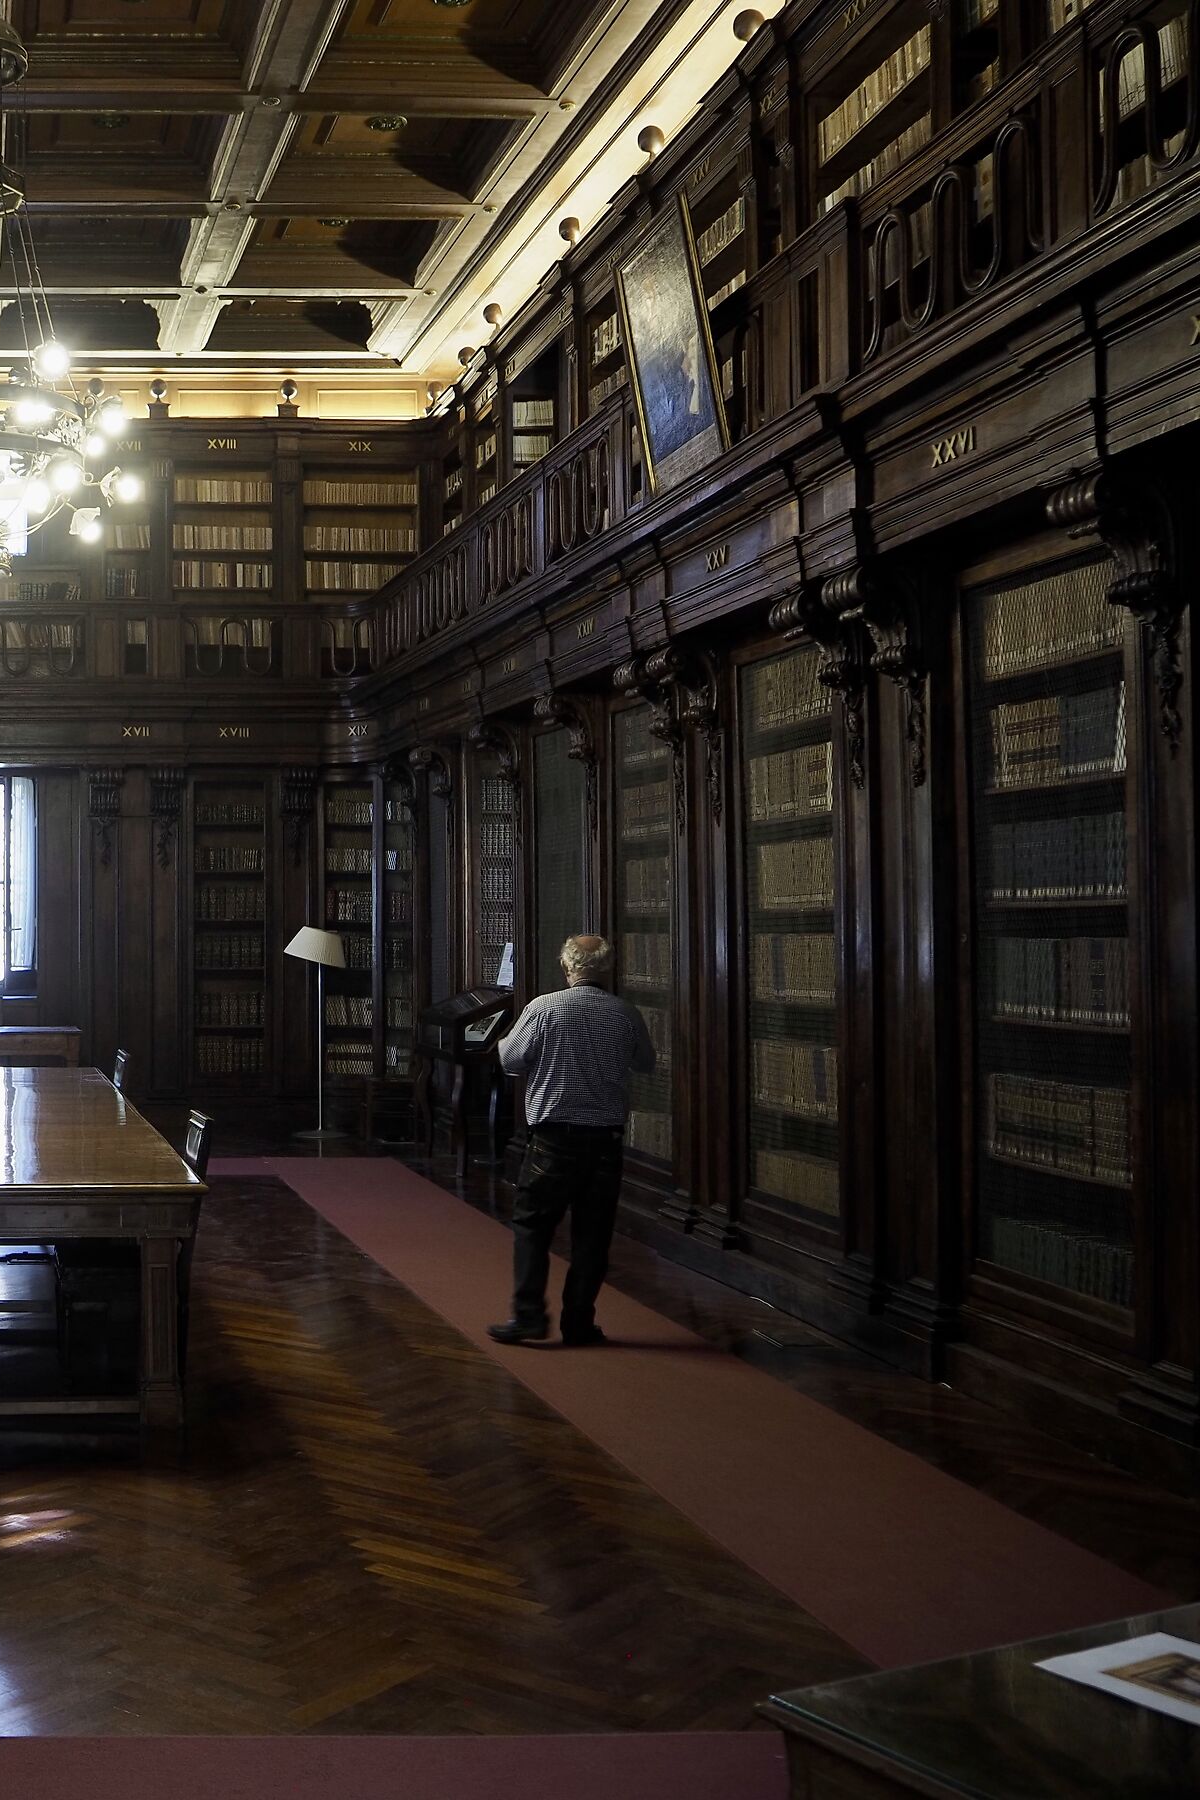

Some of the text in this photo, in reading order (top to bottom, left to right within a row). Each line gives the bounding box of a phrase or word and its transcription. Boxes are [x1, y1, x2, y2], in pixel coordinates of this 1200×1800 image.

[116, 440, 141, 451] XVII
[207, 439, 237, 450] XVIII
[348, 441, 372, 451] XIX
[932, 426, 974, 468] XXVI
[705, 545, 728, 573] XXV
[577, 616, 595, 639] XXIV
[122, 726, 150, 737] XVII
[219, 727, 249, 738] XVIII
[348, 725, 368, 736] XIX
